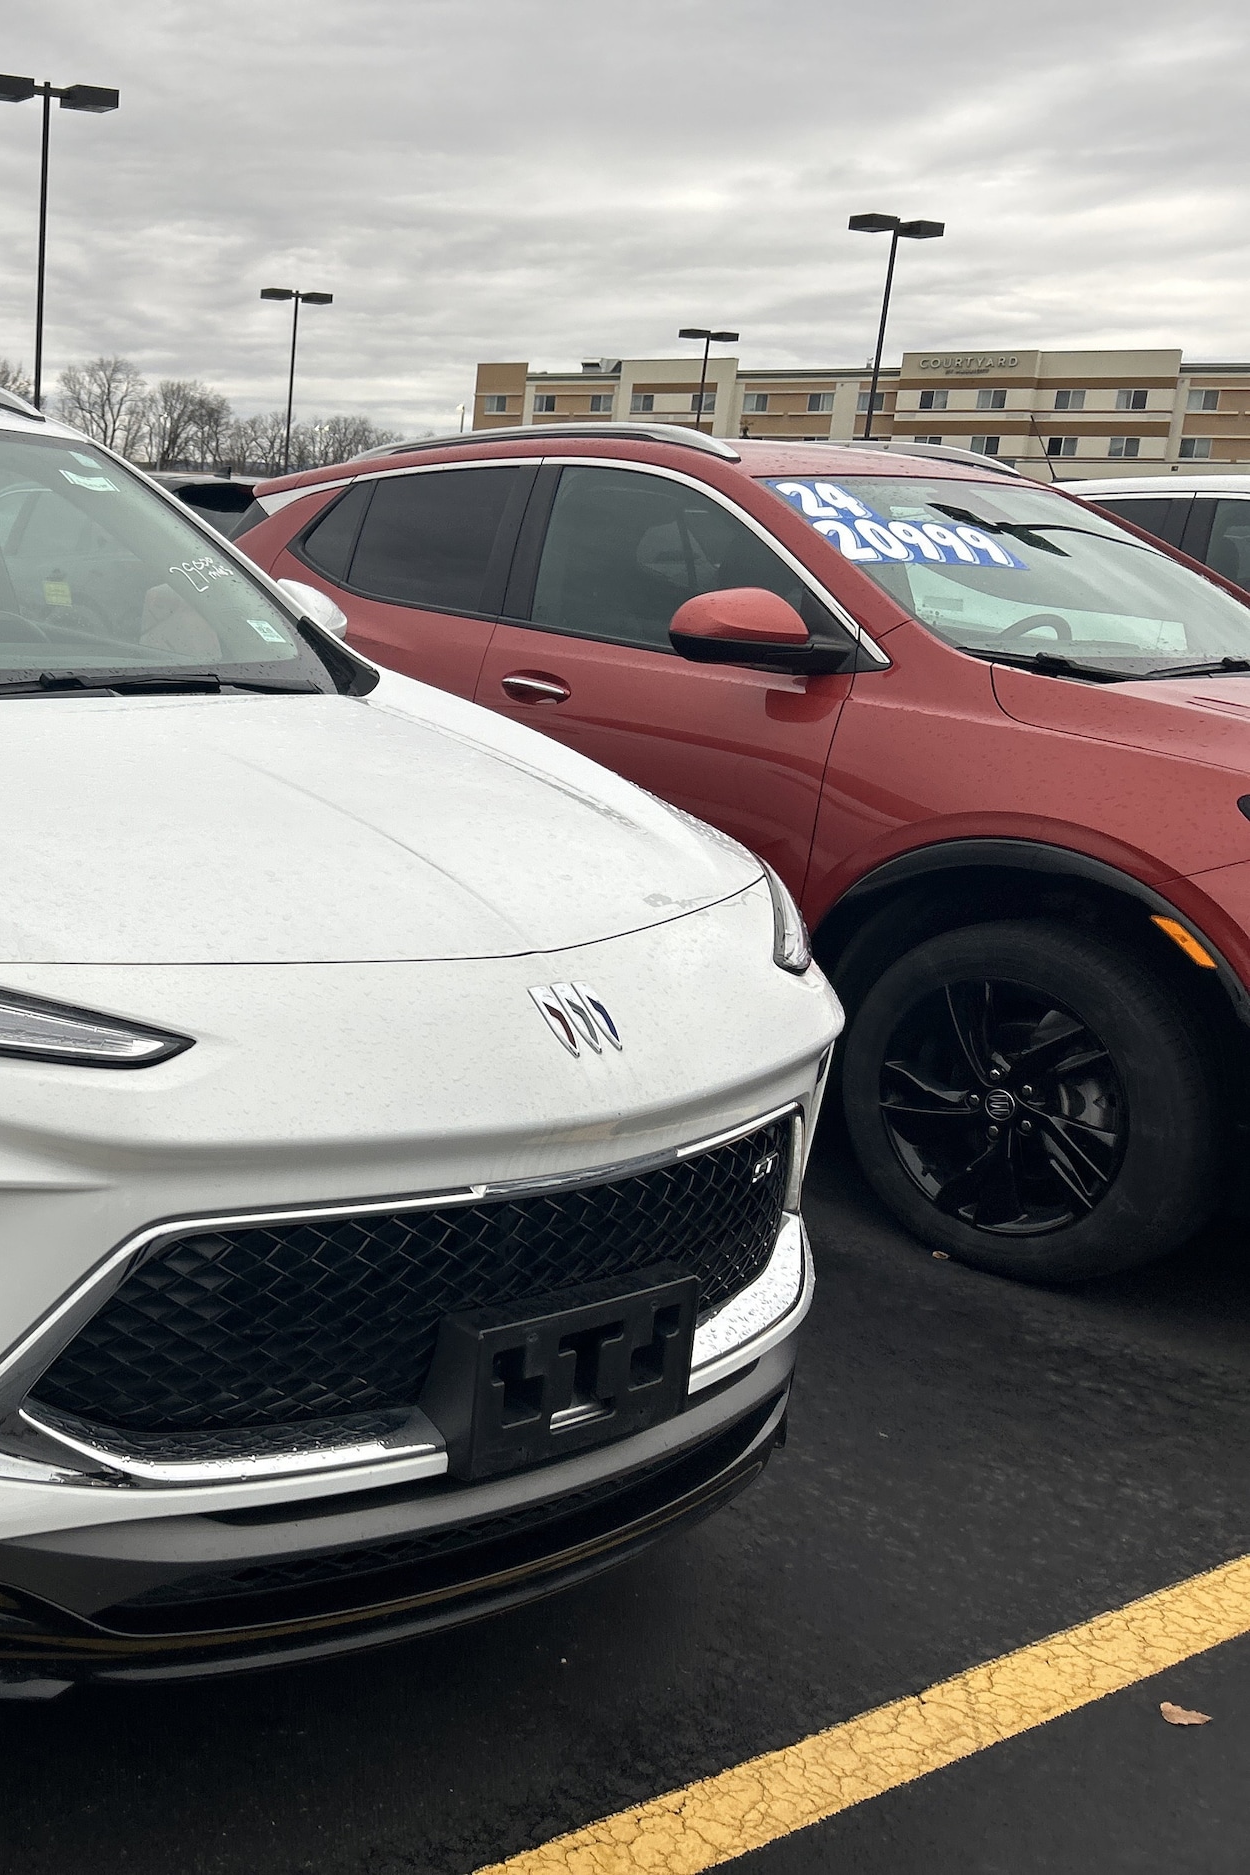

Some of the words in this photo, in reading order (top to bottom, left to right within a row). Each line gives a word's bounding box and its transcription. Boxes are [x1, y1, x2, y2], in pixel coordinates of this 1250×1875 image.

[919, 356, 1018, 368] COURTYARD
[775, 481, 872, 519] 24
[812, 518, 1014, 568] 20999
